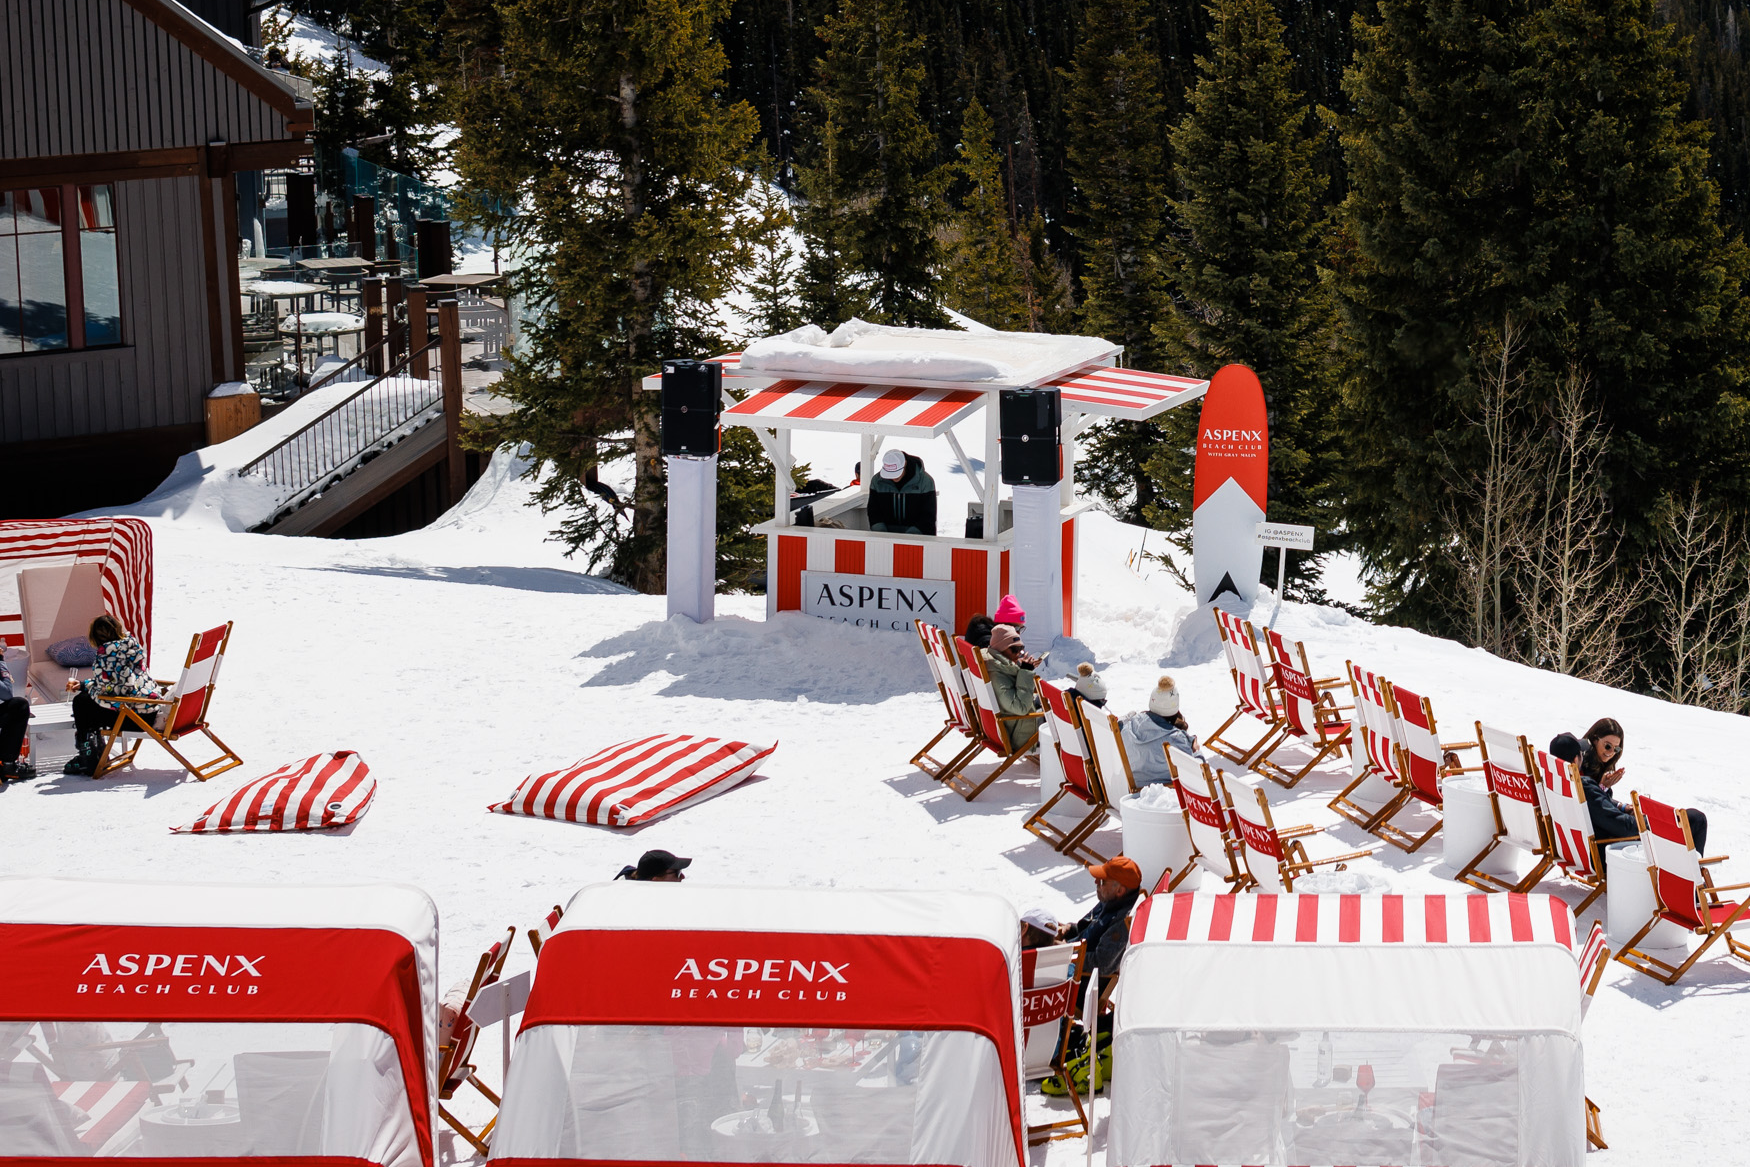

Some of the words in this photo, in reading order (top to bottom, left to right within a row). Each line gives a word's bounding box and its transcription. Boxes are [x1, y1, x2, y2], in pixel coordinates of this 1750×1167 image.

[1203, 429, 1262, 442] ASPENX
[1257, 534, 1311, 544] #aspenxbeachclub
[1273, 529, 1304, 537] @ASPENX
[817, 583, 939, 614] ASPENX
[1298, 688, 1309, 696] CLU
[1258, 844, 1273, 853] CLU
[81, 953, 266, 977] ASPENX
[673, 958, 850, 984] ASPENX
[76, 983, 171, 994] BEACH
[187, 984, 259, 995] CLUB
[670, 988, 761, 1000] BEACH
[778, 989, 847, 1001] CLUB
[1023, 988, 1067, 1011] PENX
